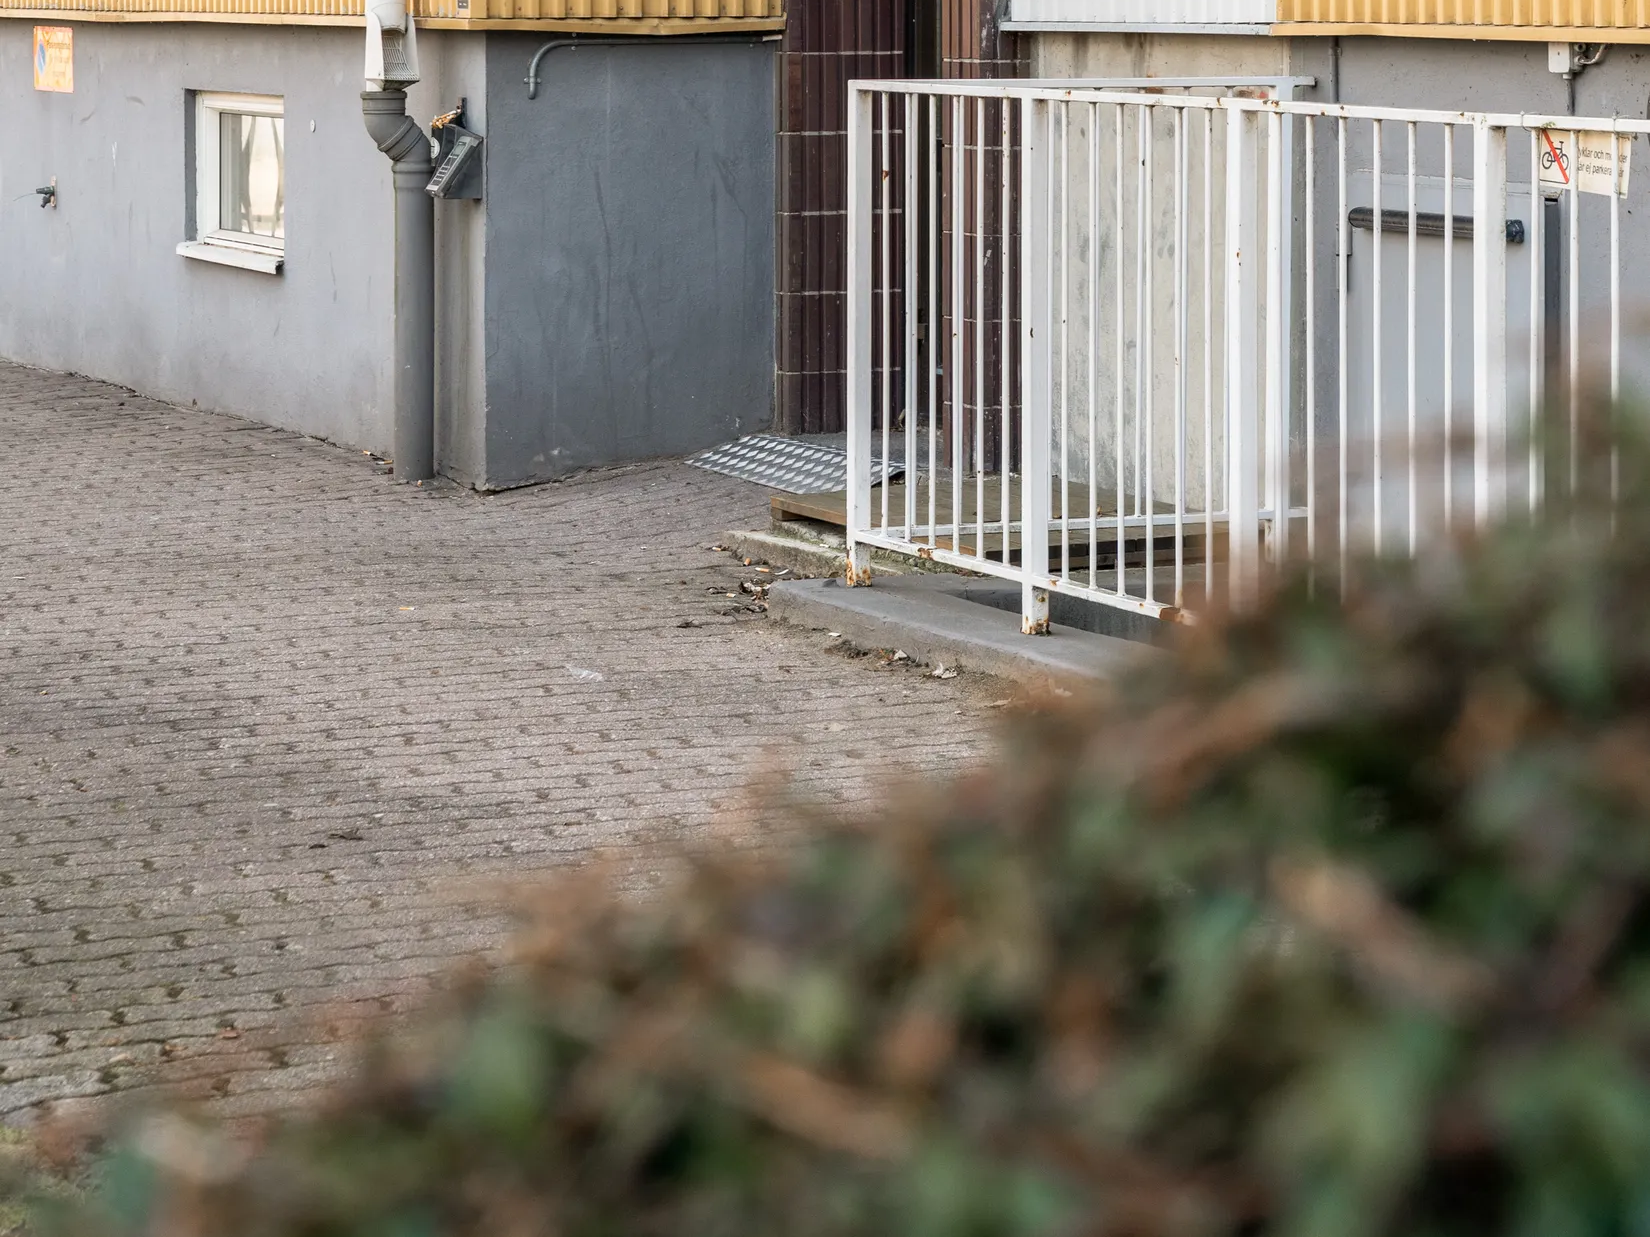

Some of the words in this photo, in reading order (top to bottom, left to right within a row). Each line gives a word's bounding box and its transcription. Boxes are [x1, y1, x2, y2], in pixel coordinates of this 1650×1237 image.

[1578, 147, 1593, 158] yklar
[1594, 150, 1604, 160] och
[1586, 163, 1591, 174] ej
[1592, 165, 1612, 176] parkera
